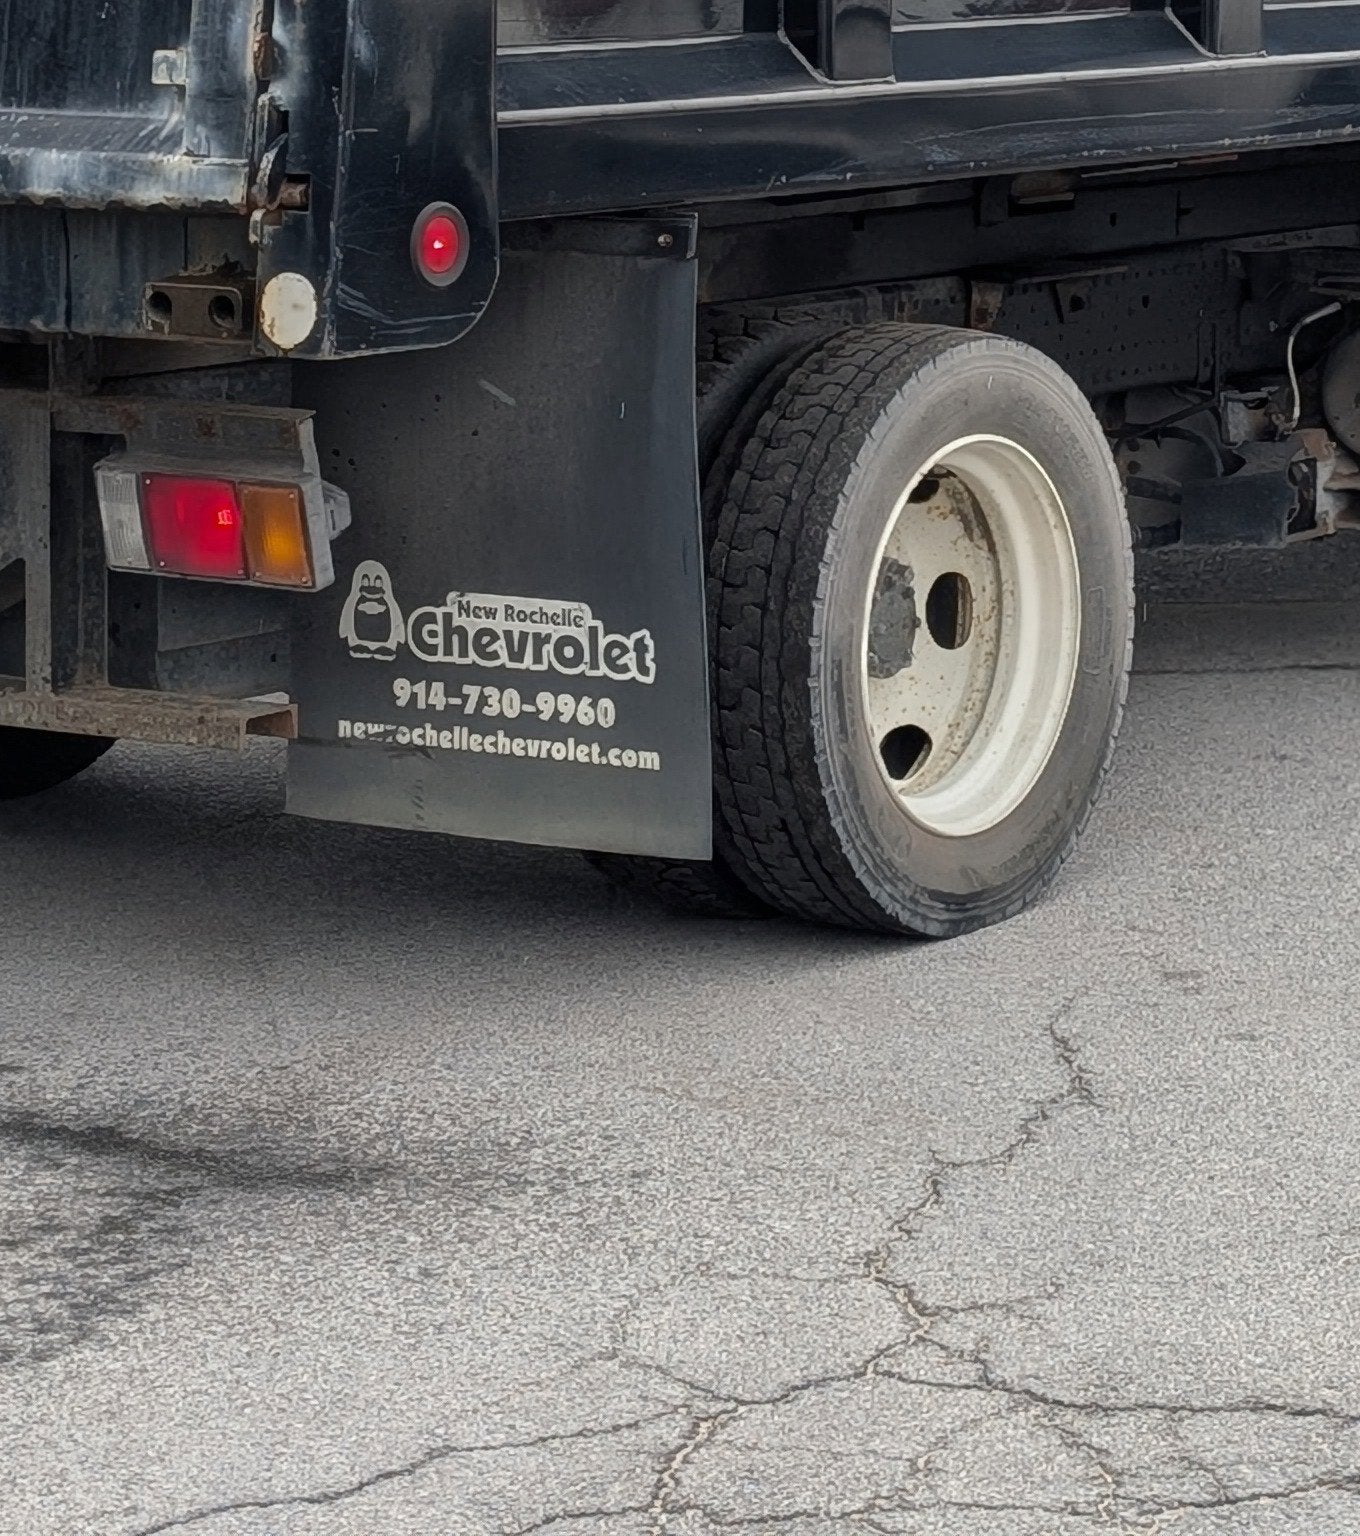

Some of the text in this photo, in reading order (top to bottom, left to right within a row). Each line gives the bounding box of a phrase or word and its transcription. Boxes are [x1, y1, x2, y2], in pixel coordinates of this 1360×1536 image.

[456, 599, 586, 630] New Rochelle
[406, 604, 657, 685] Chevrolet
[392, 677, 616, 729] 914-730-9960
